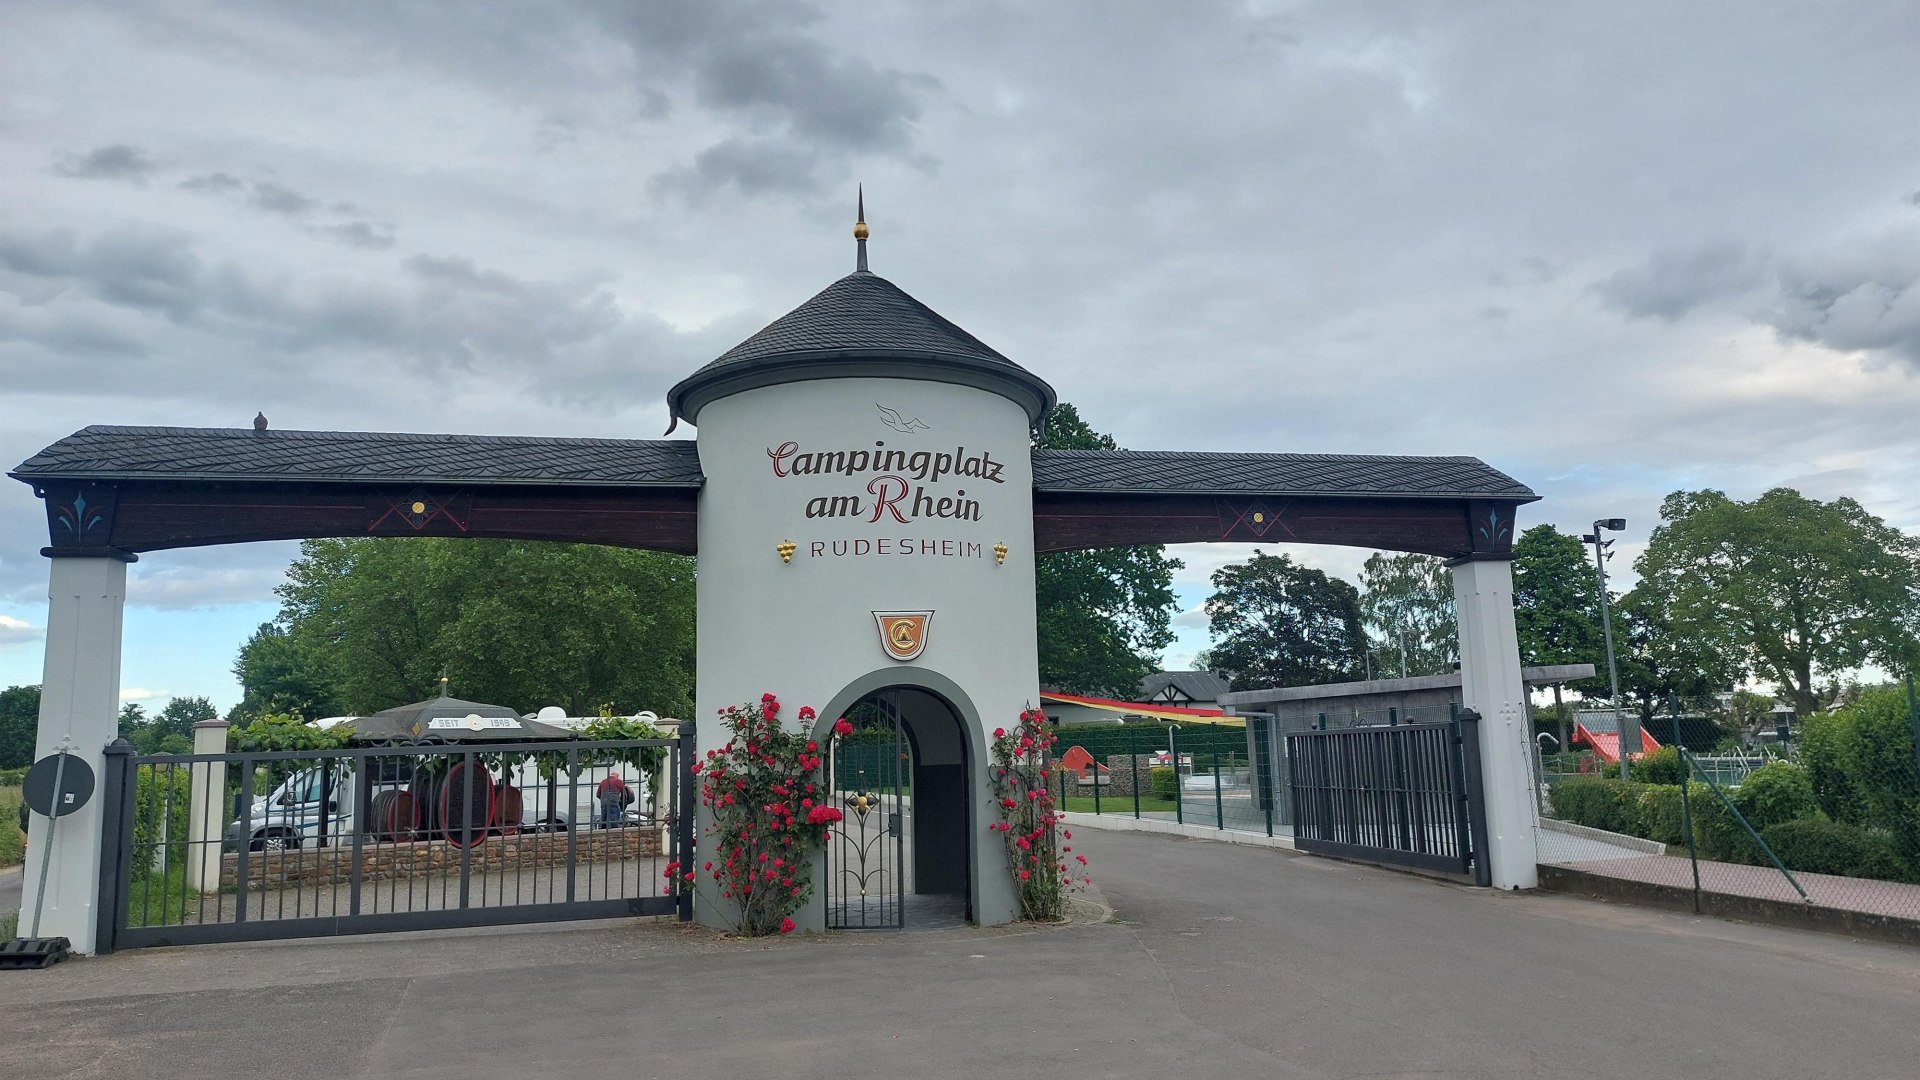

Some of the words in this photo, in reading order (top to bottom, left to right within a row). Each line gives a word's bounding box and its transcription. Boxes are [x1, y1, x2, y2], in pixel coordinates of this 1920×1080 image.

[767, 441, 1005, 484] Campingplatz
[805, 494, 867, 519] am
[866, 474, 984, 524] Rhein
[438, 719, 459, 727] SEIT
